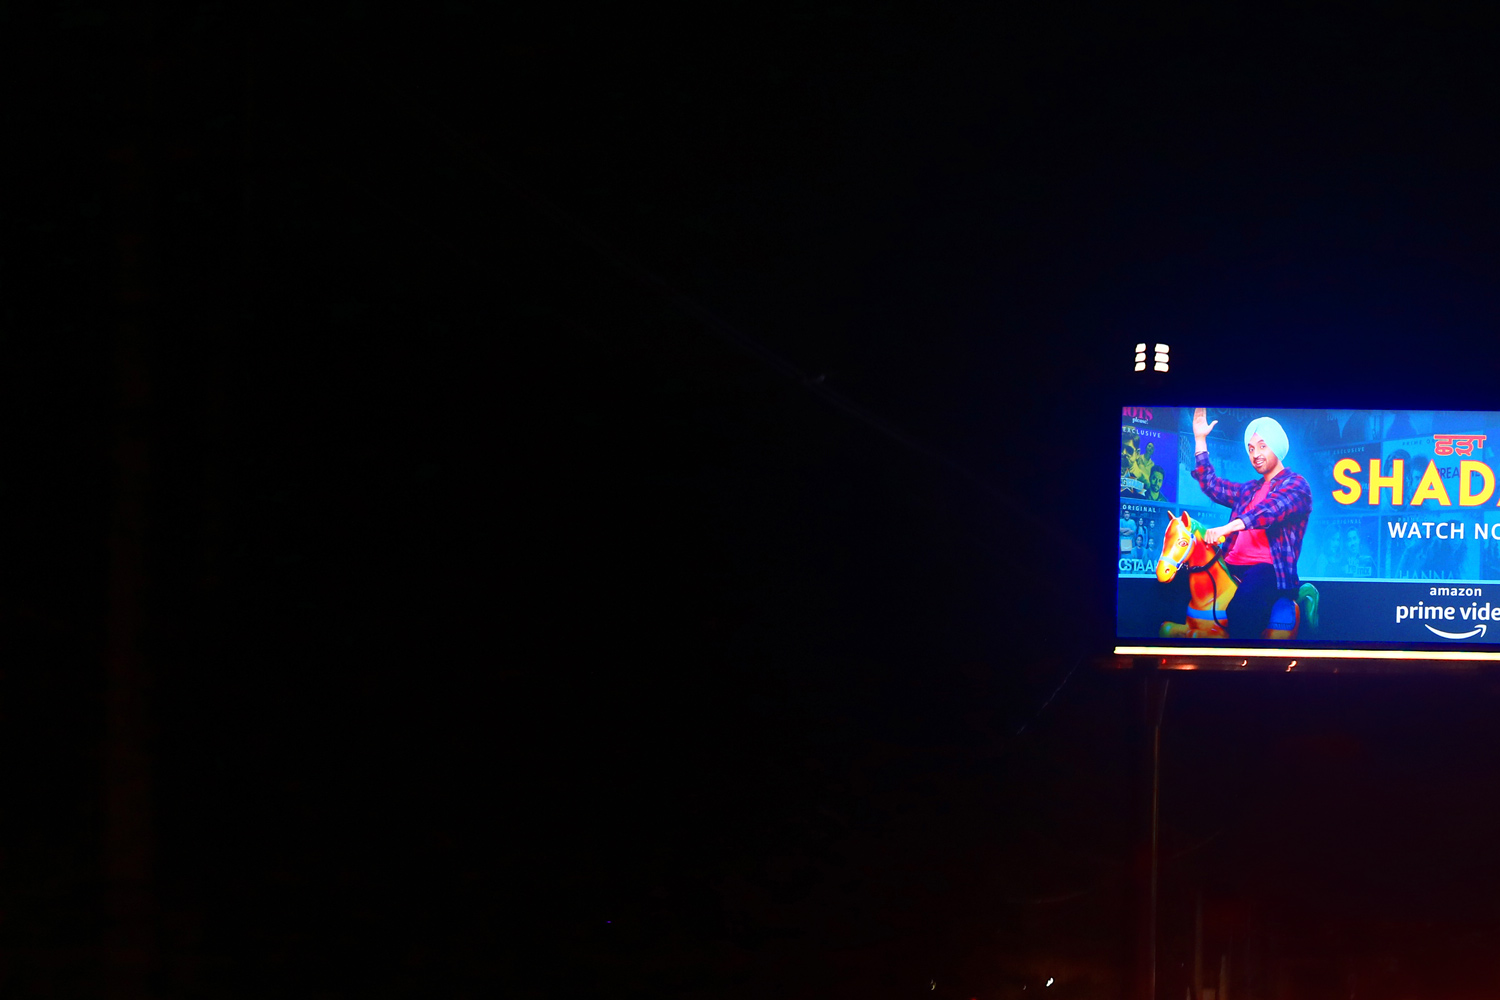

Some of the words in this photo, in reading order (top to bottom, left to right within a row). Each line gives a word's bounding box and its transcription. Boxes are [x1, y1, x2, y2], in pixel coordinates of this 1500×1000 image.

[1122, 426, 1162, 439] EXCLUSIVE
[1122, 503, 1157, 513] ORIGINAL
[1388, 521, 1464, 539] WATCH
[1429, 587, 1482, 597] amazon
[1396, 600, 1455, 623] prime
